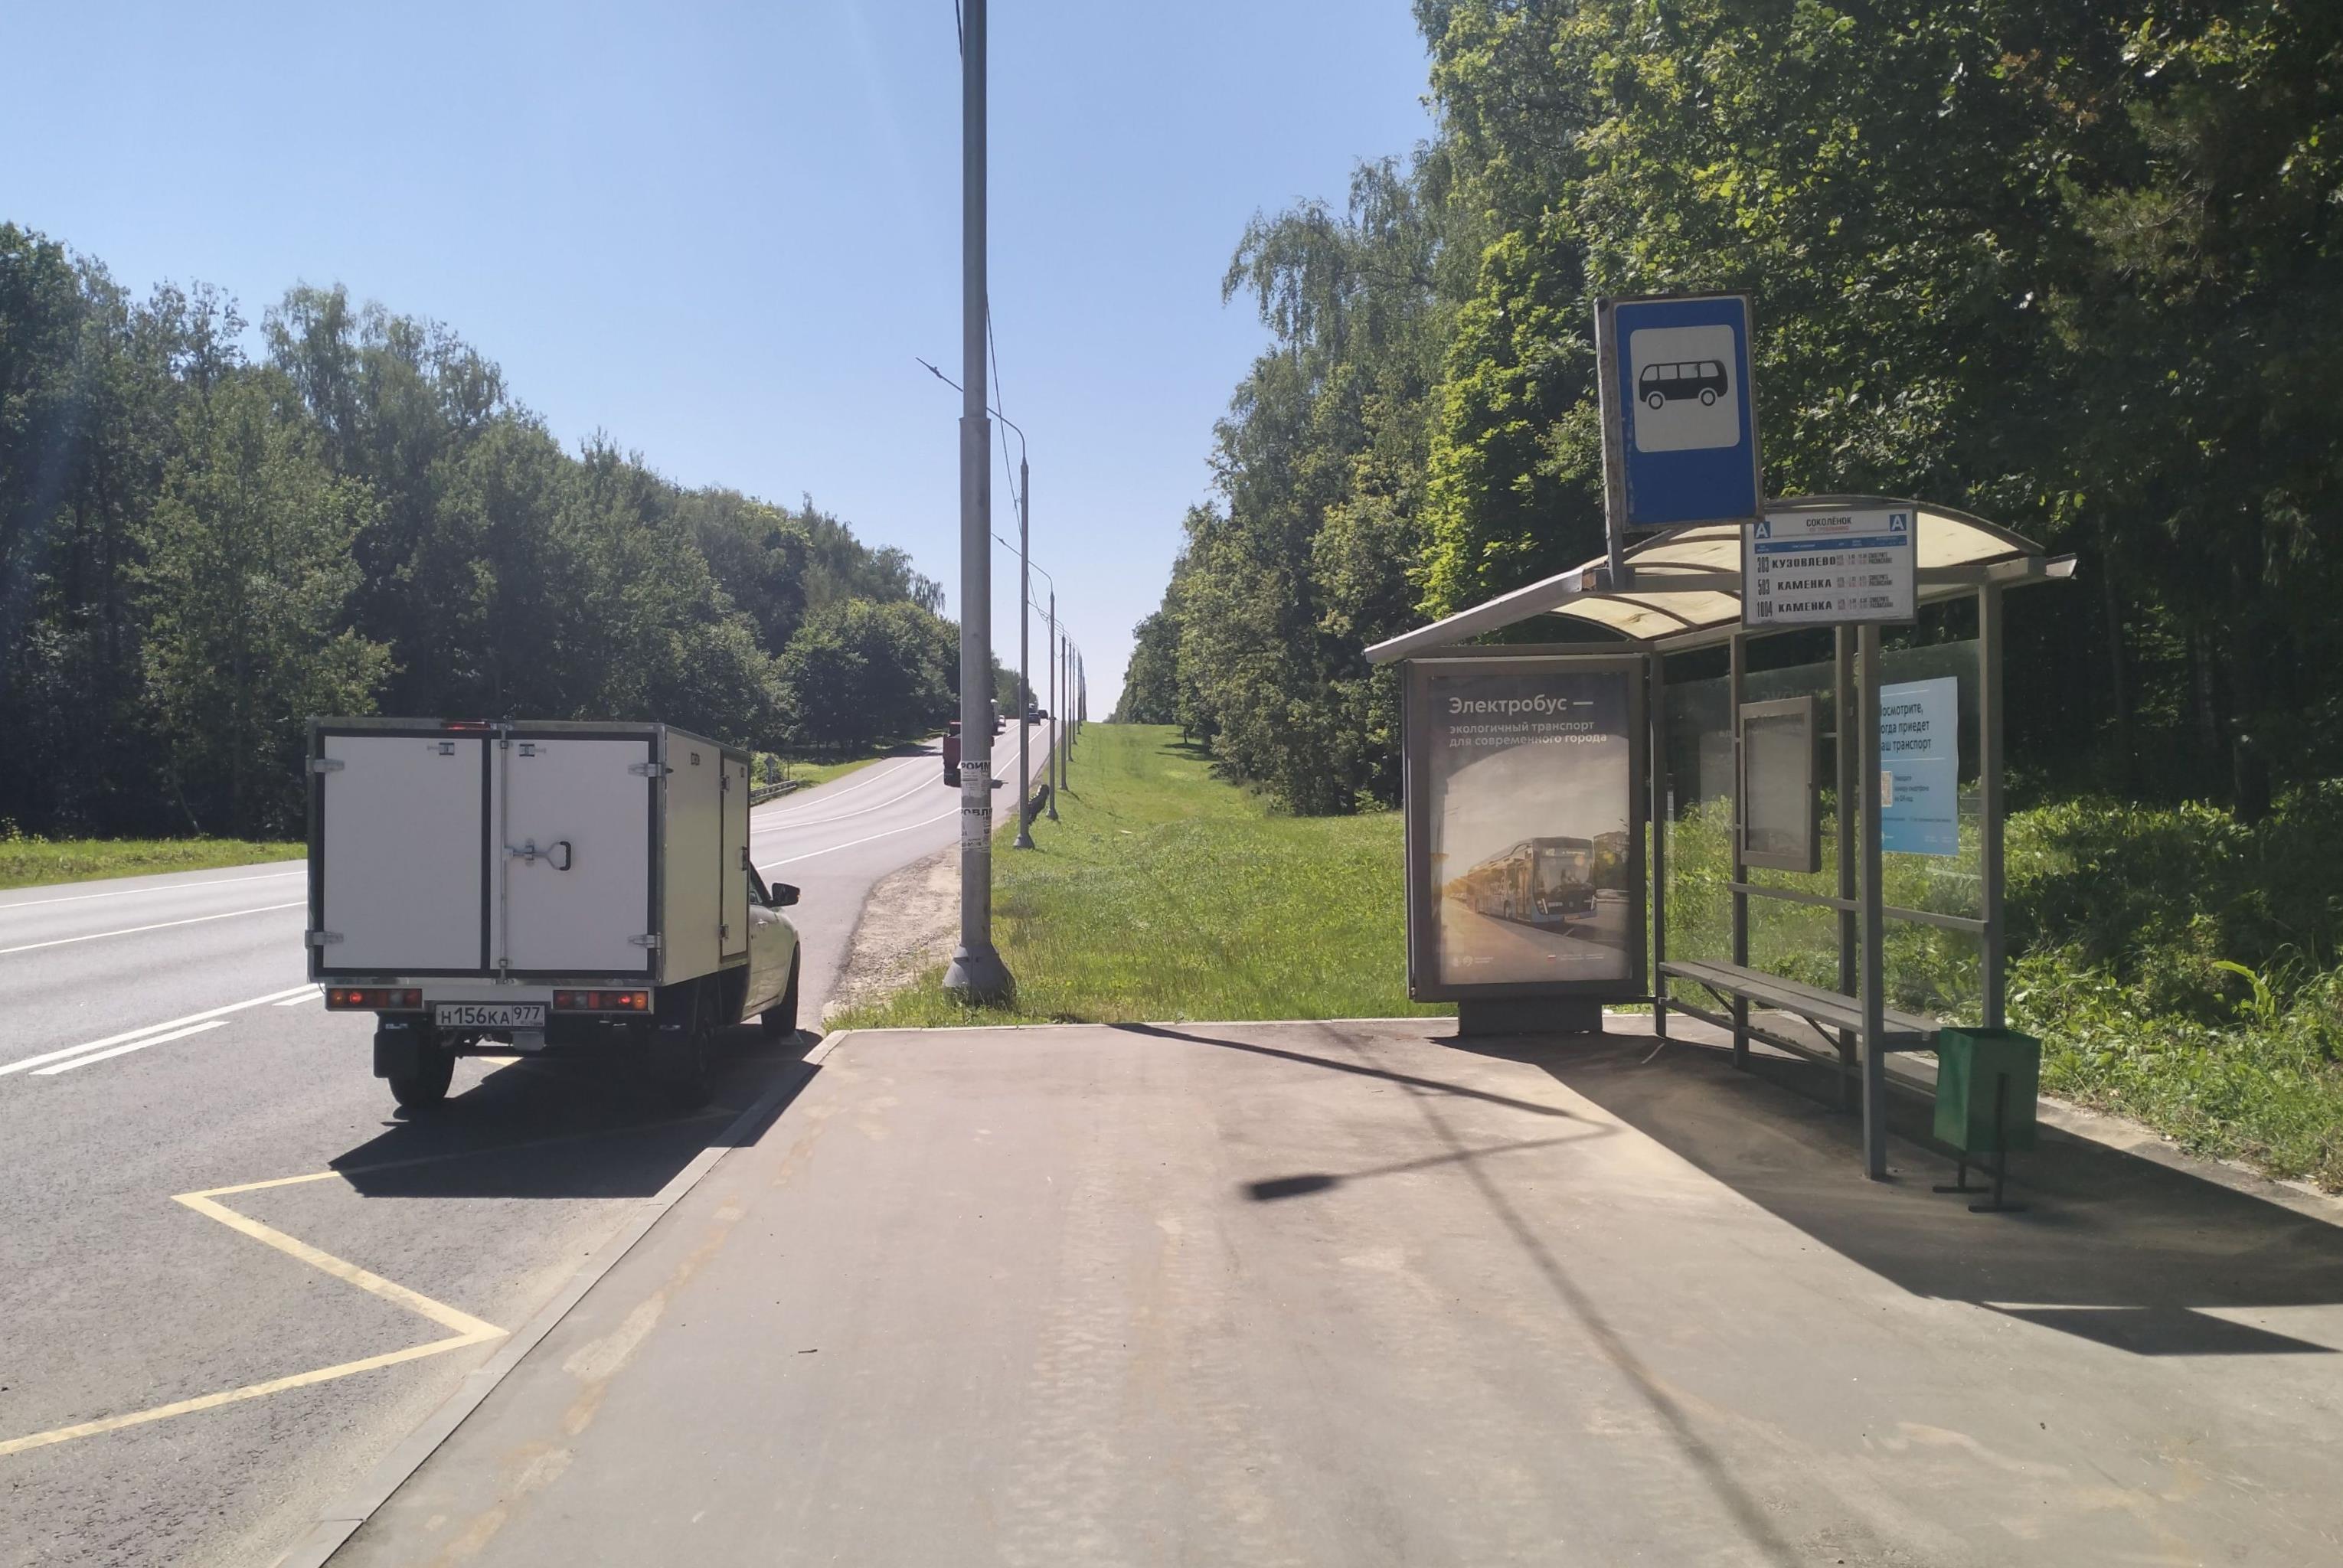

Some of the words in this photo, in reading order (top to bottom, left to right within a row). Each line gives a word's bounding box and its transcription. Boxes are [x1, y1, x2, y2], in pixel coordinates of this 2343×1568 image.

[1772, 557, 1836, 569] КУЗОВЛЕВО
[1758, 578, 1770, 596] 503
[1777, 578, 1832, 590] КАМЕНКА
[1778, 601, 1832, 613] КАМЕНКА
[1449, 694, 1567, 716] Электробус
[1449, 721, 1529, 734] экологичный
[1531, 721, 1594, 733] транспорт
[1881, 724, 1897, 735] огда
[1898, 720, 1930, 735] приедет
[1449, 736, 1472, 747] для
[1475, 735, 1562, 747] современного
[1565, 734, 1607, 744] города
[1881, 741, 1891, 751] аш
[1892, 739, 1932, 753] транспорт
